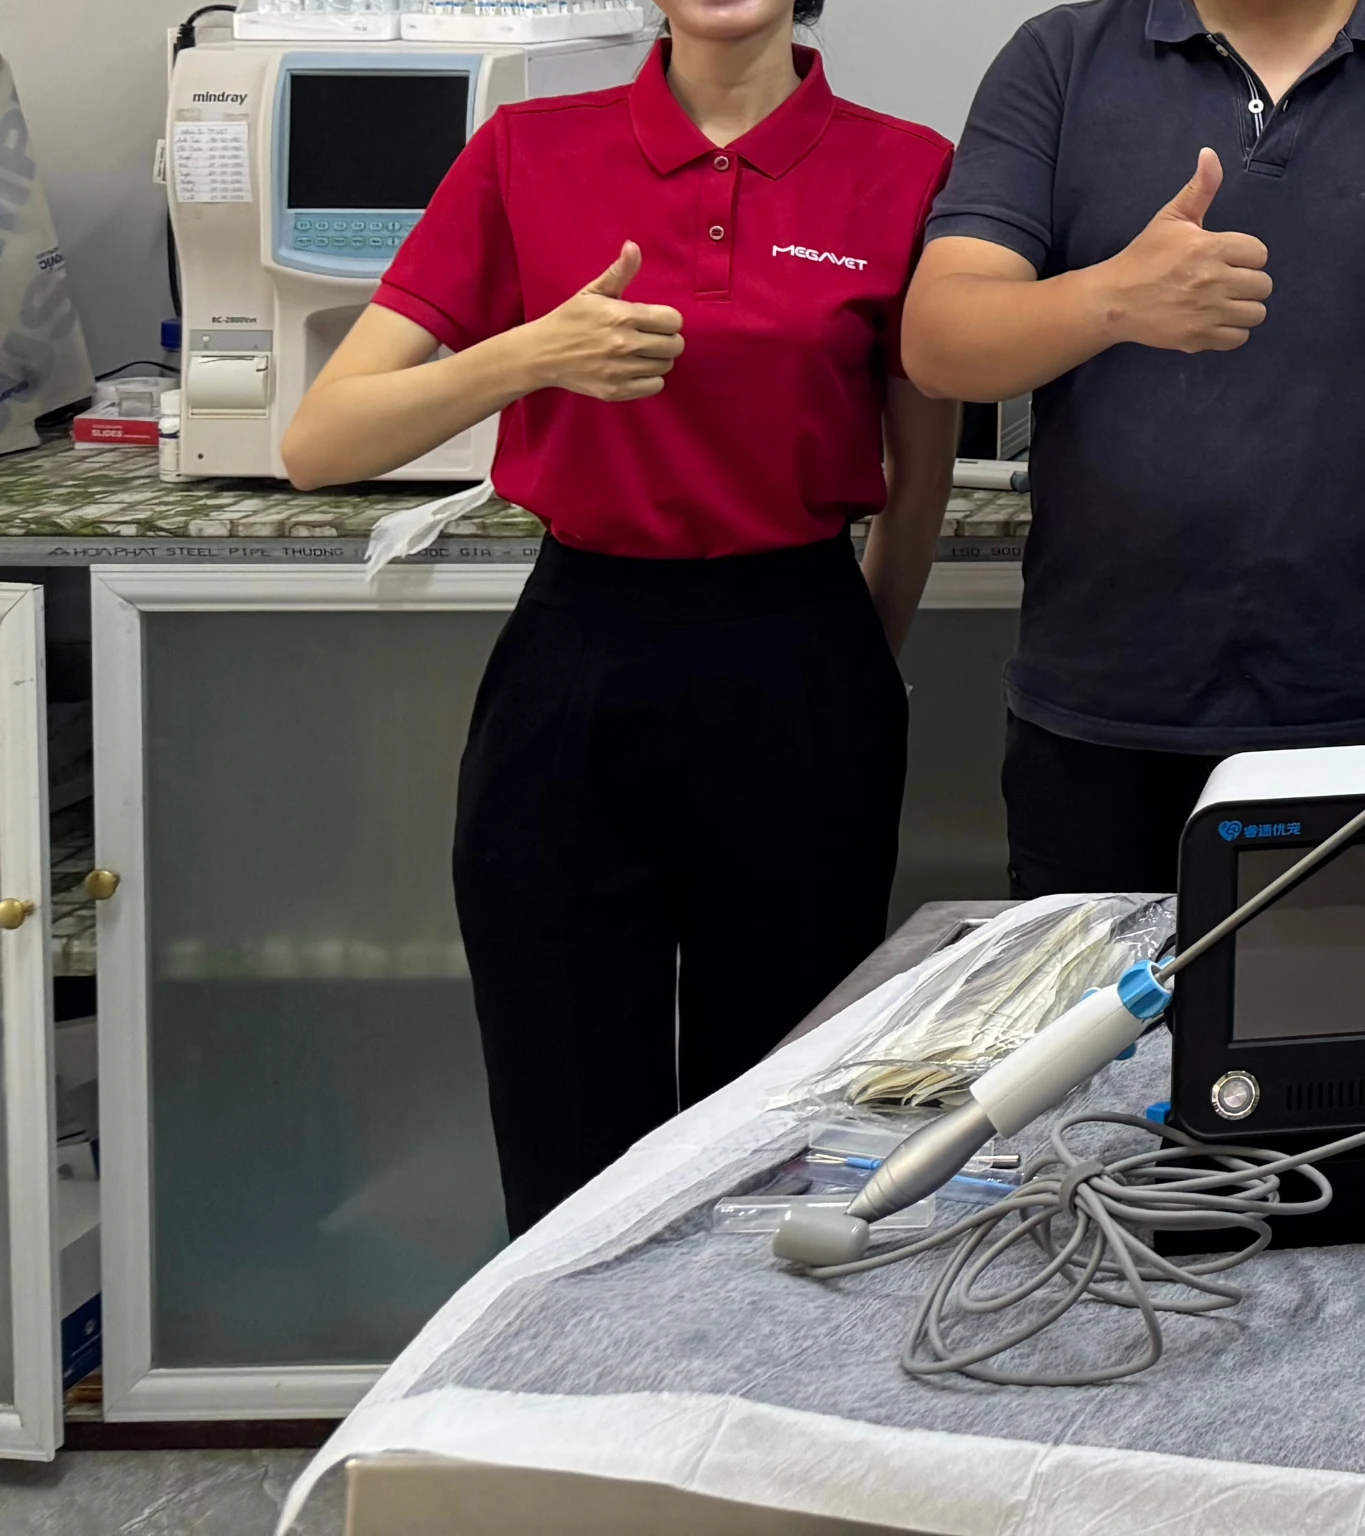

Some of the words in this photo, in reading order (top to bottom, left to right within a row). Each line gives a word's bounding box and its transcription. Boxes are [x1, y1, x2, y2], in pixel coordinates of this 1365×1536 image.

[192, 91, 249, 106] mindray
[771, 244, 868, 271] MEGAVET
[91, 429, 123, 438] SLIDES
[166, 547, 220, 557] STEEL
[229, 548, 273, 557] PIPE
[283, 547, 344, 557] THUONG
[459, 548, 492, 557] GIA
